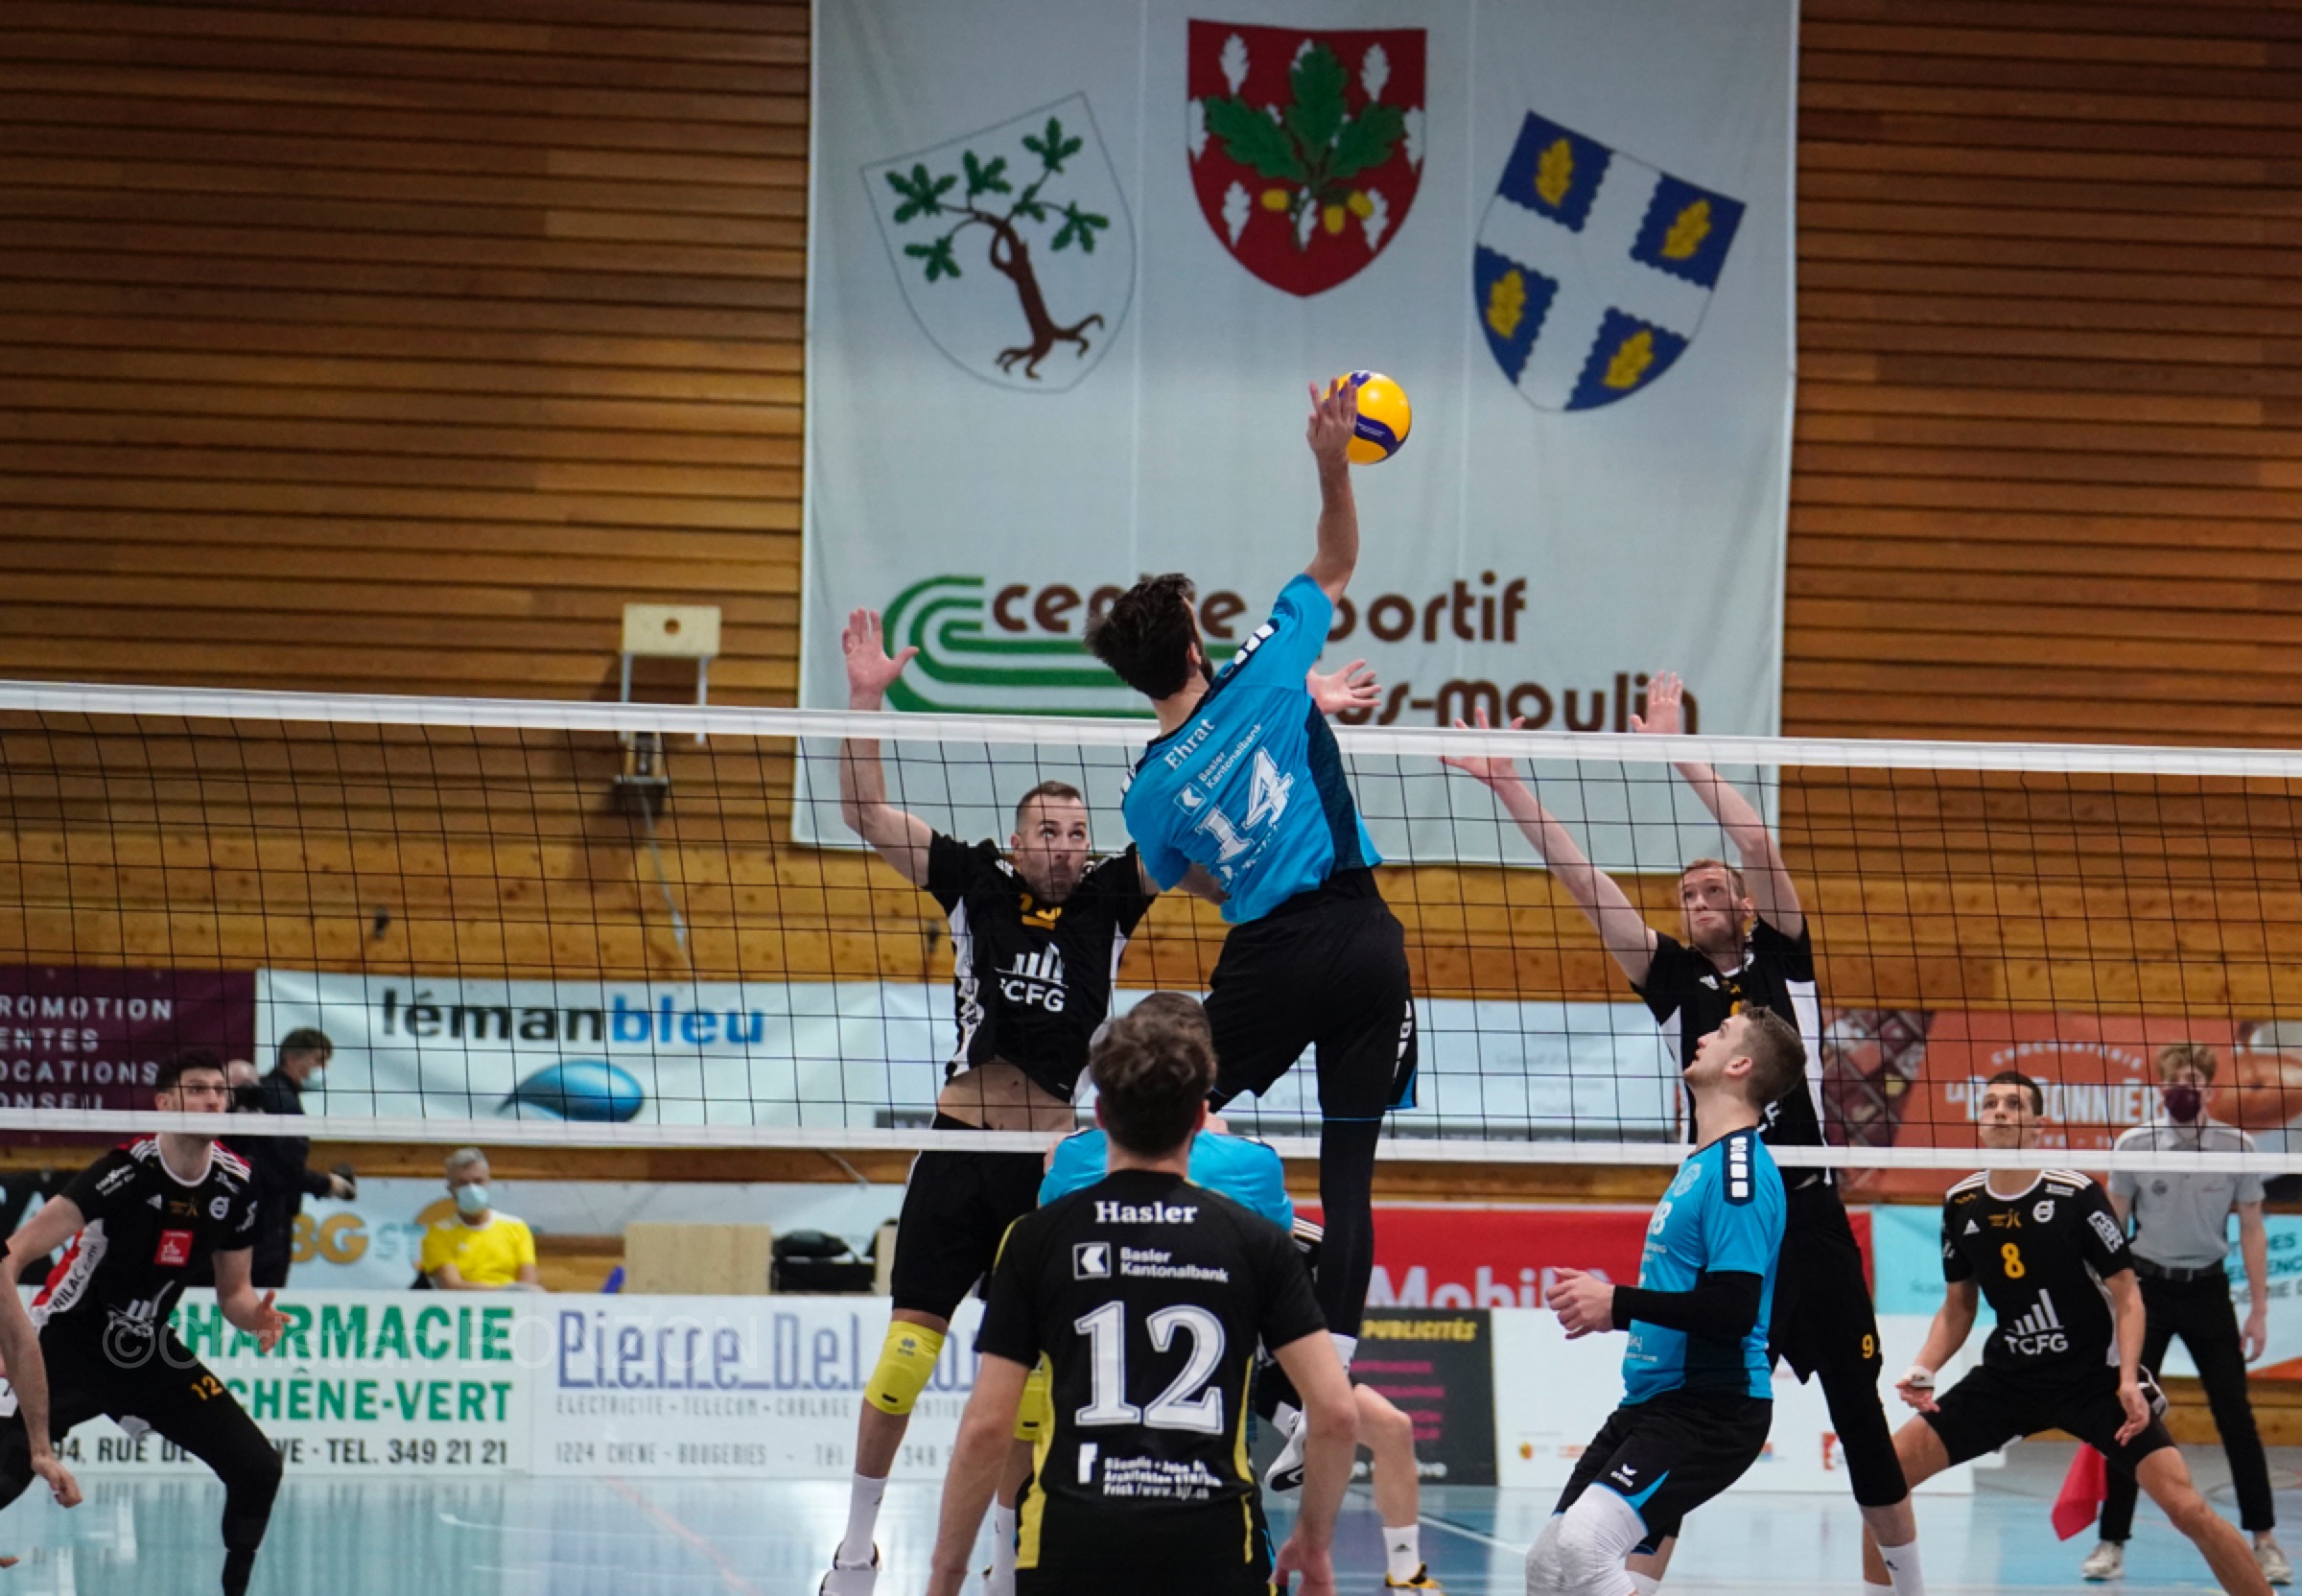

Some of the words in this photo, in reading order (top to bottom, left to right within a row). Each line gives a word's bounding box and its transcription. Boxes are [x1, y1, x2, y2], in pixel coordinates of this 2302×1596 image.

[1163, 719, 1215, 770] Ehrat
[1194, 745, 1295, 863] 14
[1093, 1200, 1198, 1225] Hasler
[1119, 1246, 1172, 1263] Basler
[2000, 1242, 2026, 1279] 8
[1119, 1261, 1230, 1283] Kantonalbank
[169, 1303, 515, 1361] HARMACIE
[2004, 1333, 2069, 1355] TCFG
[1861, 1334, 1875, 1360] 9
[1073, 1300, 1226, 1434] 12
[191, 1373, 223, 1401] 12
[99, 1436, 149, 1463] RUE
[388, 1438, 437, 1465] 349
[446, 1439, 472, 1465] 21
[482, 1439, 507, 1465] 21
